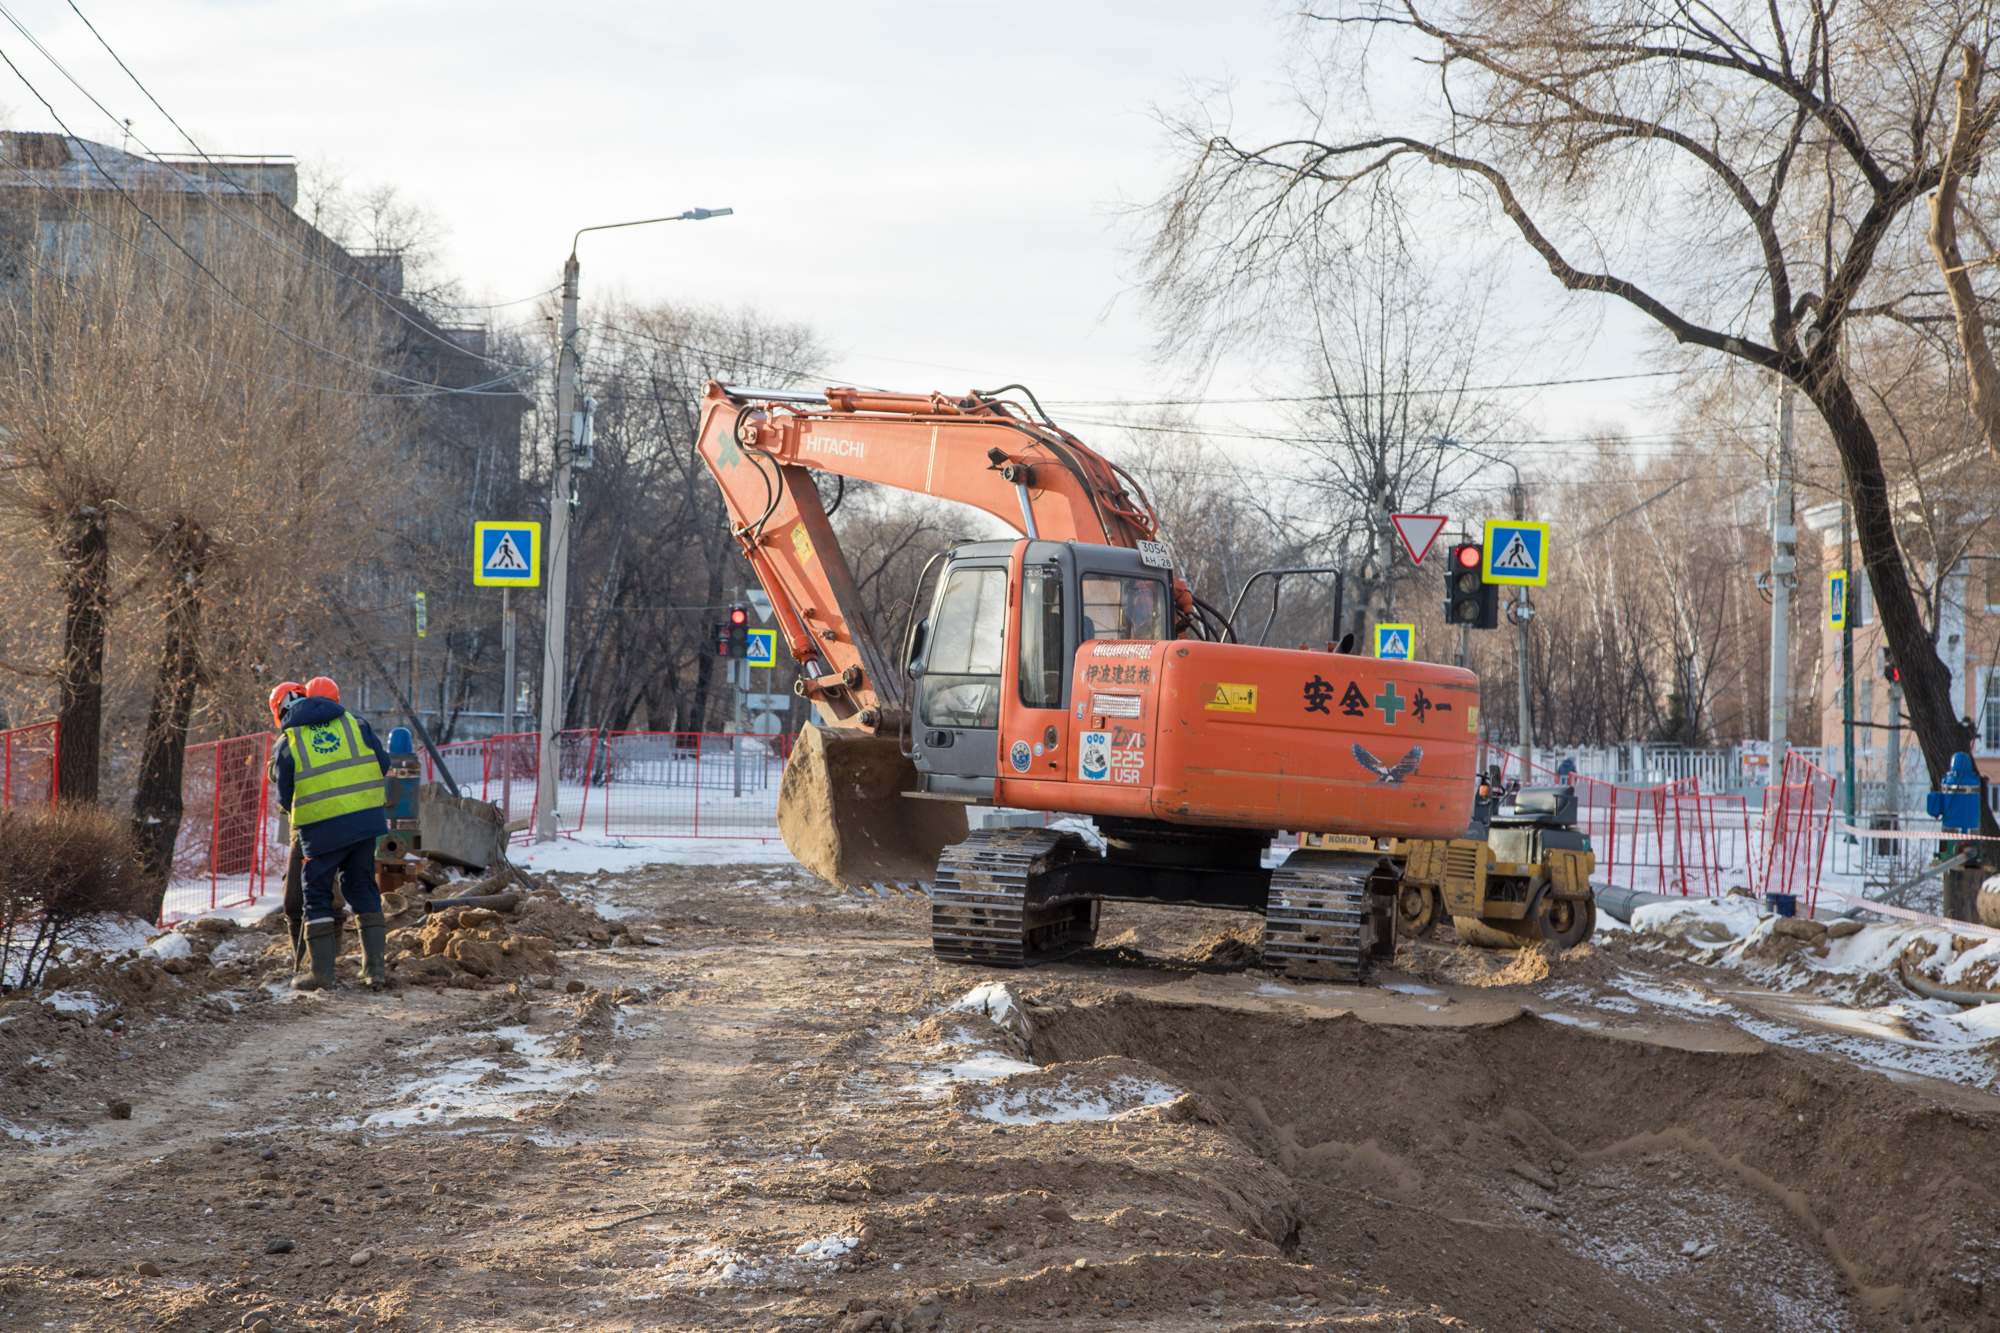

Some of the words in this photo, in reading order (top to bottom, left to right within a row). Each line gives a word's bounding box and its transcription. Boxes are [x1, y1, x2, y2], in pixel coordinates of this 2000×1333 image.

[806, 435, 864, 458] HITACHI
[1141, 541, 1167, 555] 3054
[1160, 558, 1172, 567] 28
[1302, 675, 1370, 717] 安全
[1111, 725, 1147, 750] ZAXIS
[1111, 749, 1145, 769] 225
[1114, 768, 1140, 785] USR
[1328, 834, 1369, 845] KOMATSU
